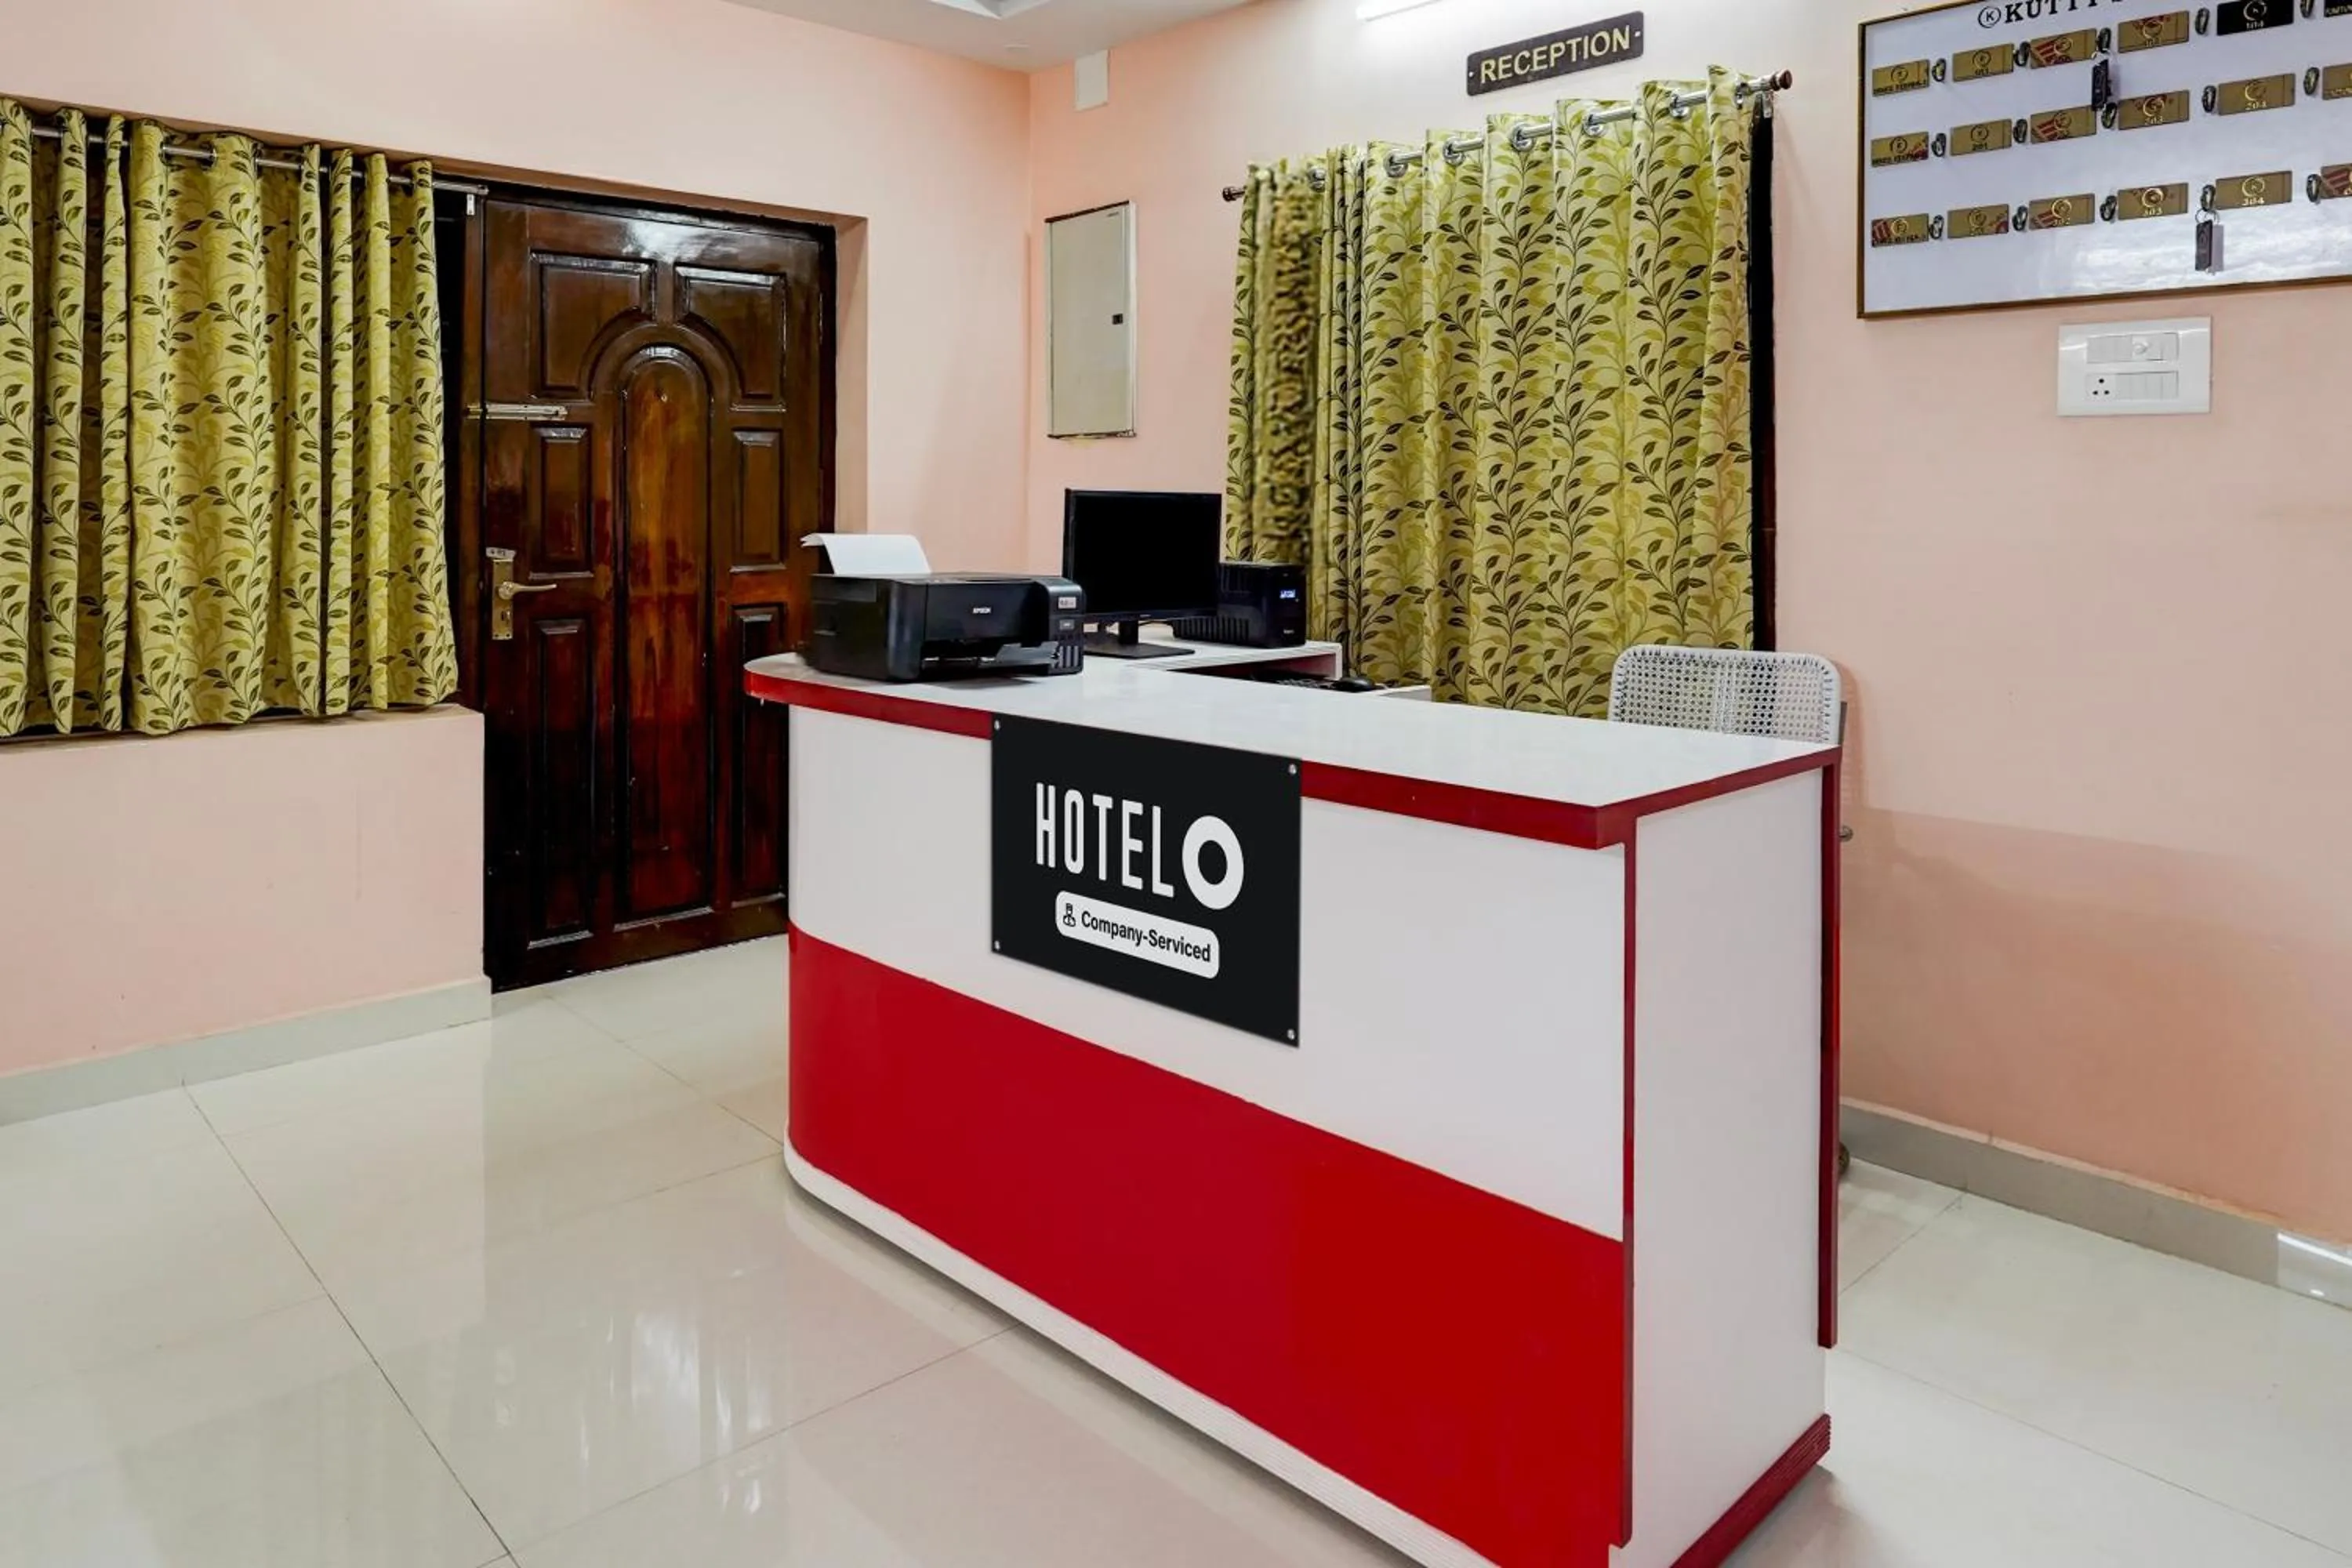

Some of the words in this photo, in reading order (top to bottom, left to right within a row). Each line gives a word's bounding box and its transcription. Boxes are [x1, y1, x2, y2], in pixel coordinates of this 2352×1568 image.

[1480, 24, 1631, 84] RECEPTION
[1036, 782, 1174, 898] HOTEL
[1081, 910, 1211, 963] Company-Serviced
